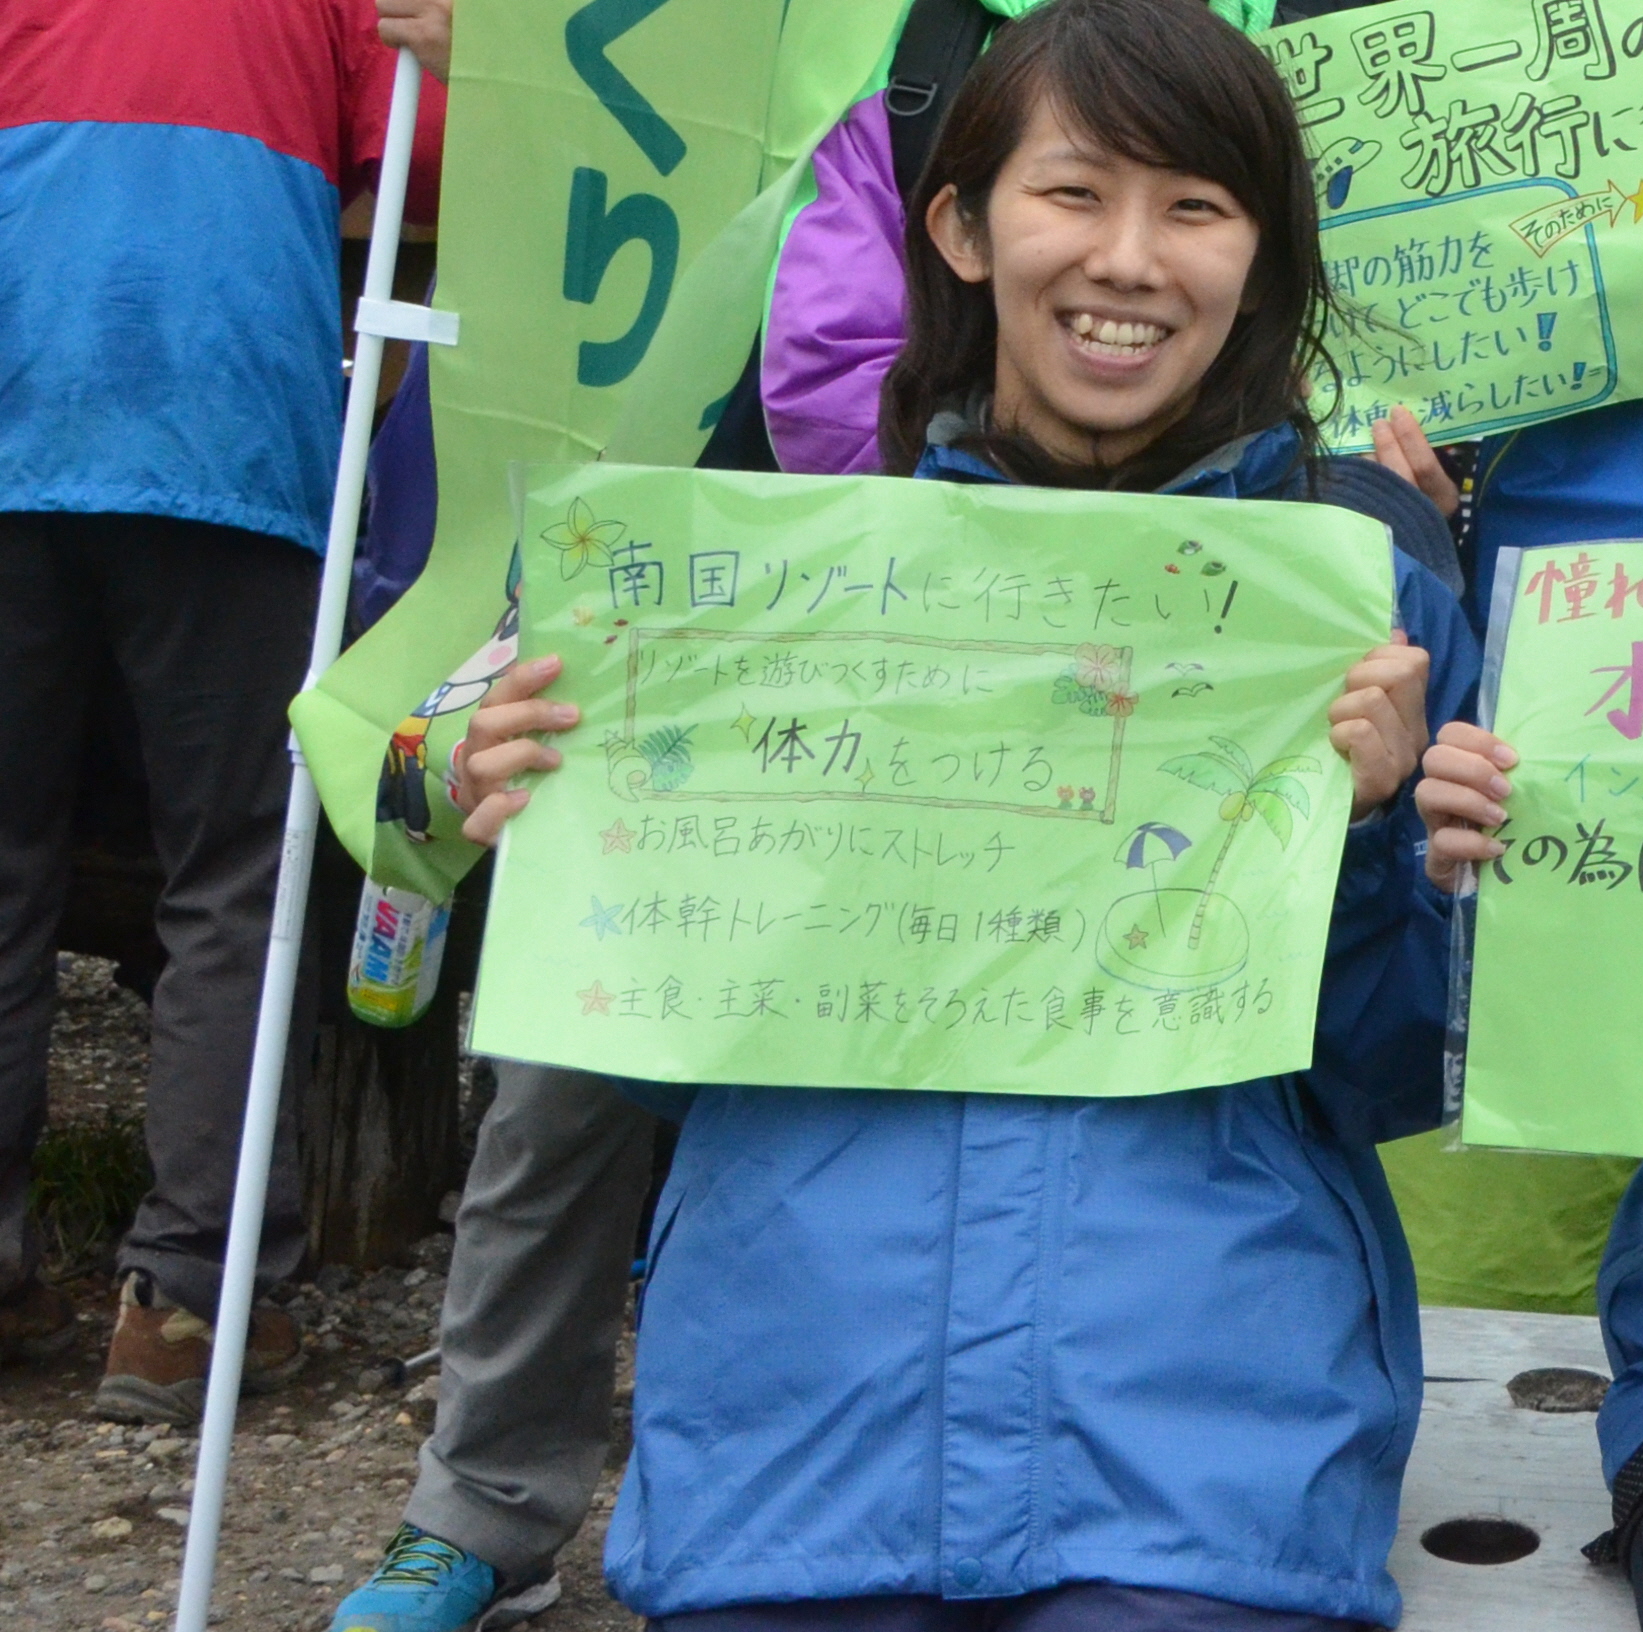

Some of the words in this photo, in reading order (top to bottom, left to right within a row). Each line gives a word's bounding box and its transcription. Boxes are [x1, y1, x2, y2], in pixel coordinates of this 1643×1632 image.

[1521, 197, 1614, 249] そのために
[609, 540, 1239, 635] 南国リゾートに行きたい!
[637, 650, 994, 697] リゾートを遊びつくすために
[752, 716, 1054, 792] 体力をつける
[637, 813, 1016, 872] お風呂あがりにストレッチ
[362, 898, 401, 983] VAAM
